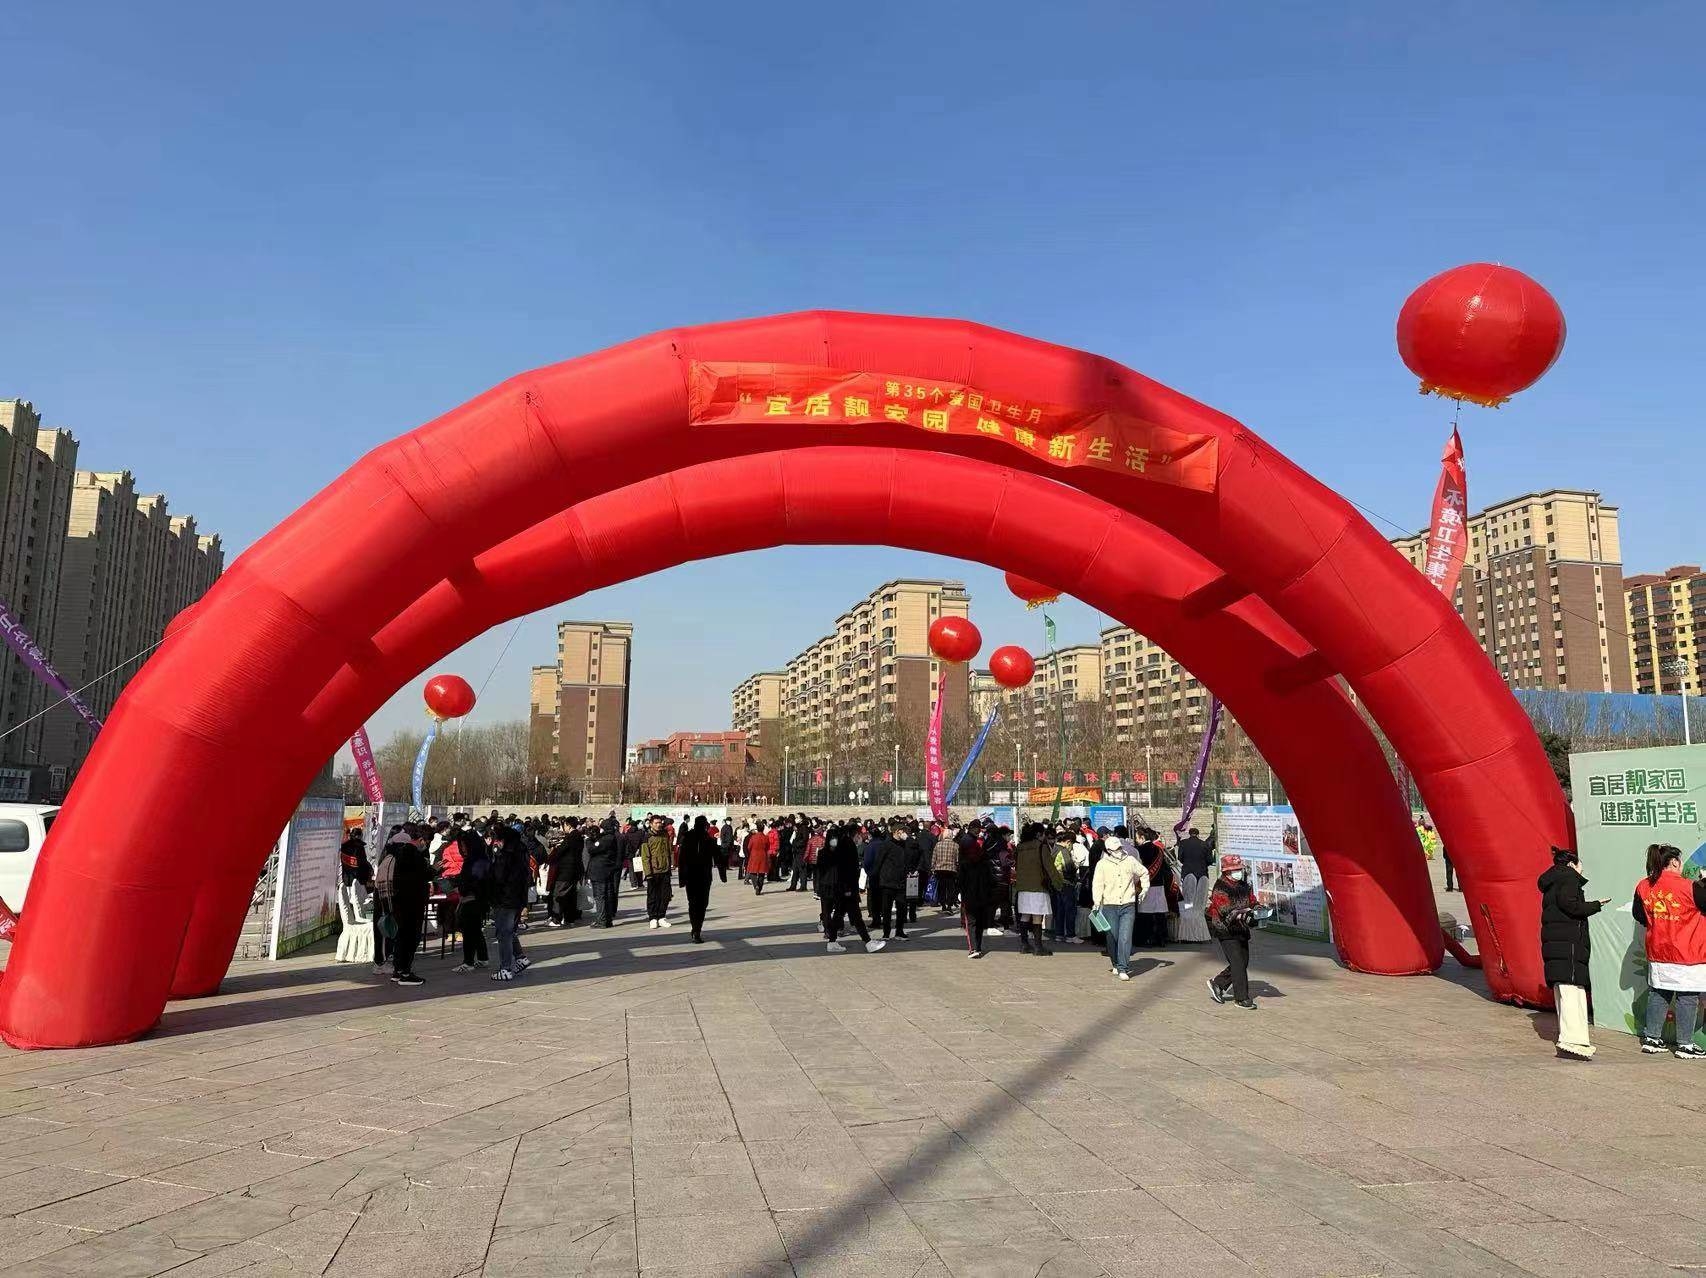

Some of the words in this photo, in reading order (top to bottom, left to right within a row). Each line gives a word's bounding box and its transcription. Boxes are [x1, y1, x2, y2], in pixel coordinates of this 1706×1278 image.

[885, 381, 1042, 424] 第35个爱国卫生月
[1588, 768, 1687, 796] 宜居靓家园
[1599, 799, 1698, 828] 健康新生活
